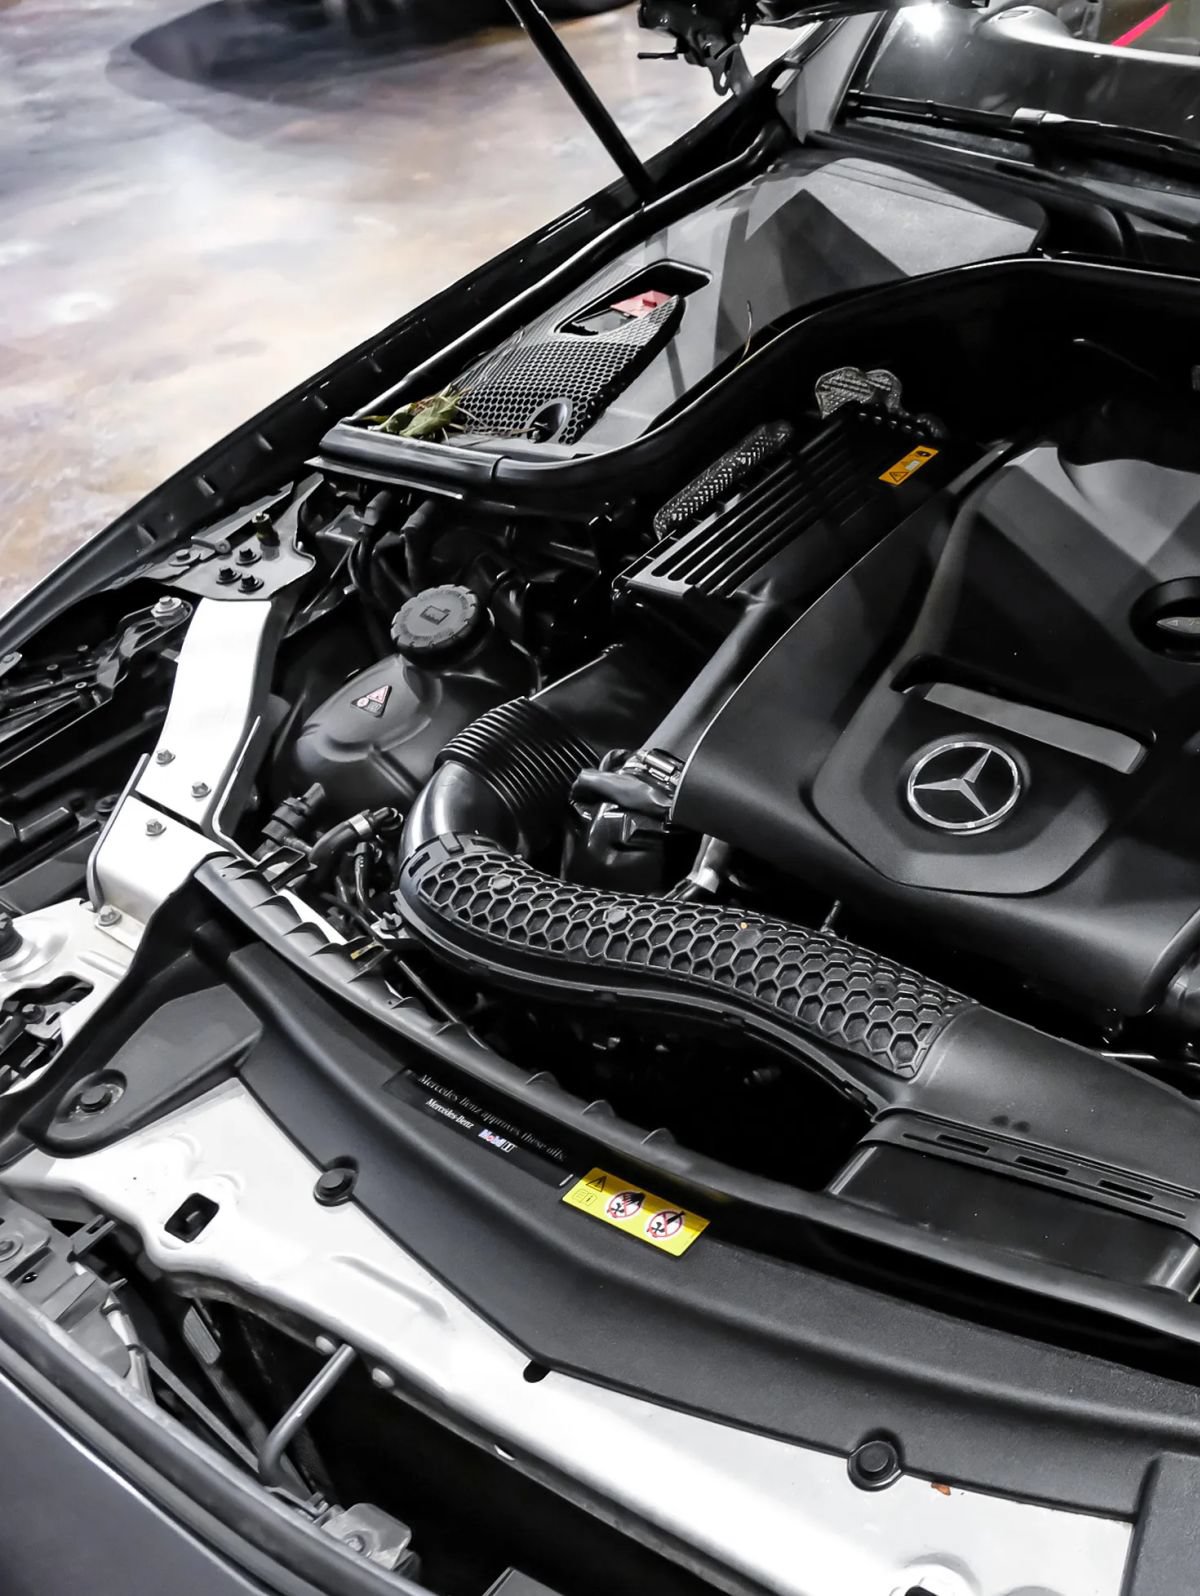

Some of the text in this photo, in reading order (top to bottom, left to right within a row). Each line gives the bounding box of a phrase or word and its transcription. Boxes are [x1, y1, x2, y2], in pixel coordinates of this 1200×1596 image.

[418, 1074, 483, 1114] Mercedes-Benz
[481, 1111, 521, 1137] approves
[520, 1131, 547, 1152] these
[426, 1098, 475, 1129] Mercedes-Benz
